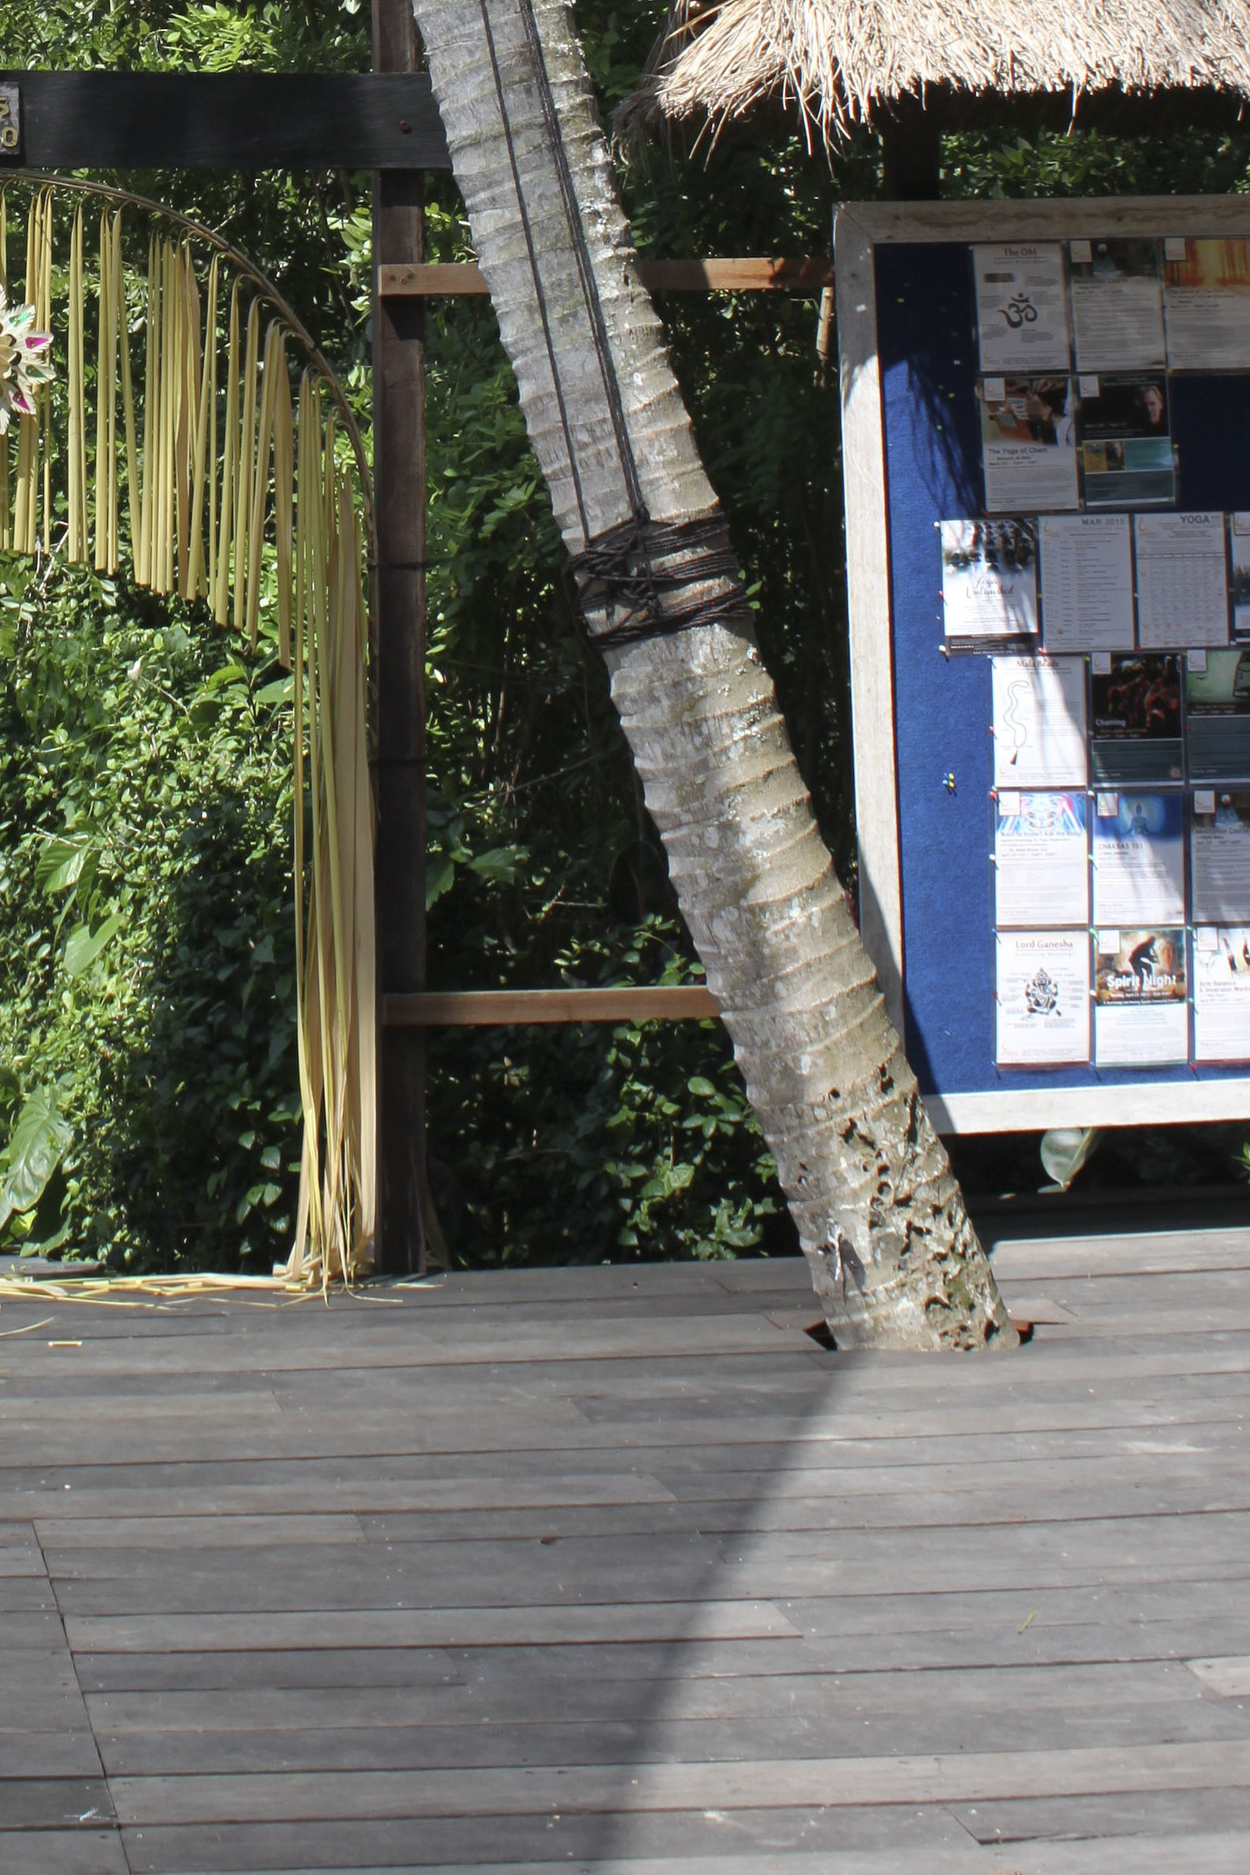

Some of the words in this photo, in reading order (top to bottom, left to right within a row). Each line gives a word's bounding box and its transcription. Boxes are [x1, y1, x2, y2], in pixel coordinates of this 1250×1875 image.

[1081, 517, 1102, 526] MAR
[1180, 514, 1211, 525] YOGA
[1095, 718, 1126, 727] Chanting
[1098, 842, 1130, 850] CHAKRAS
[1015, 939, 1035, 949] Lord
[1037, 938, 1074, 949] Ganesha
[1106, 975, 1140, 990] Spirit
[1144, 974, 1177, 989] Night
